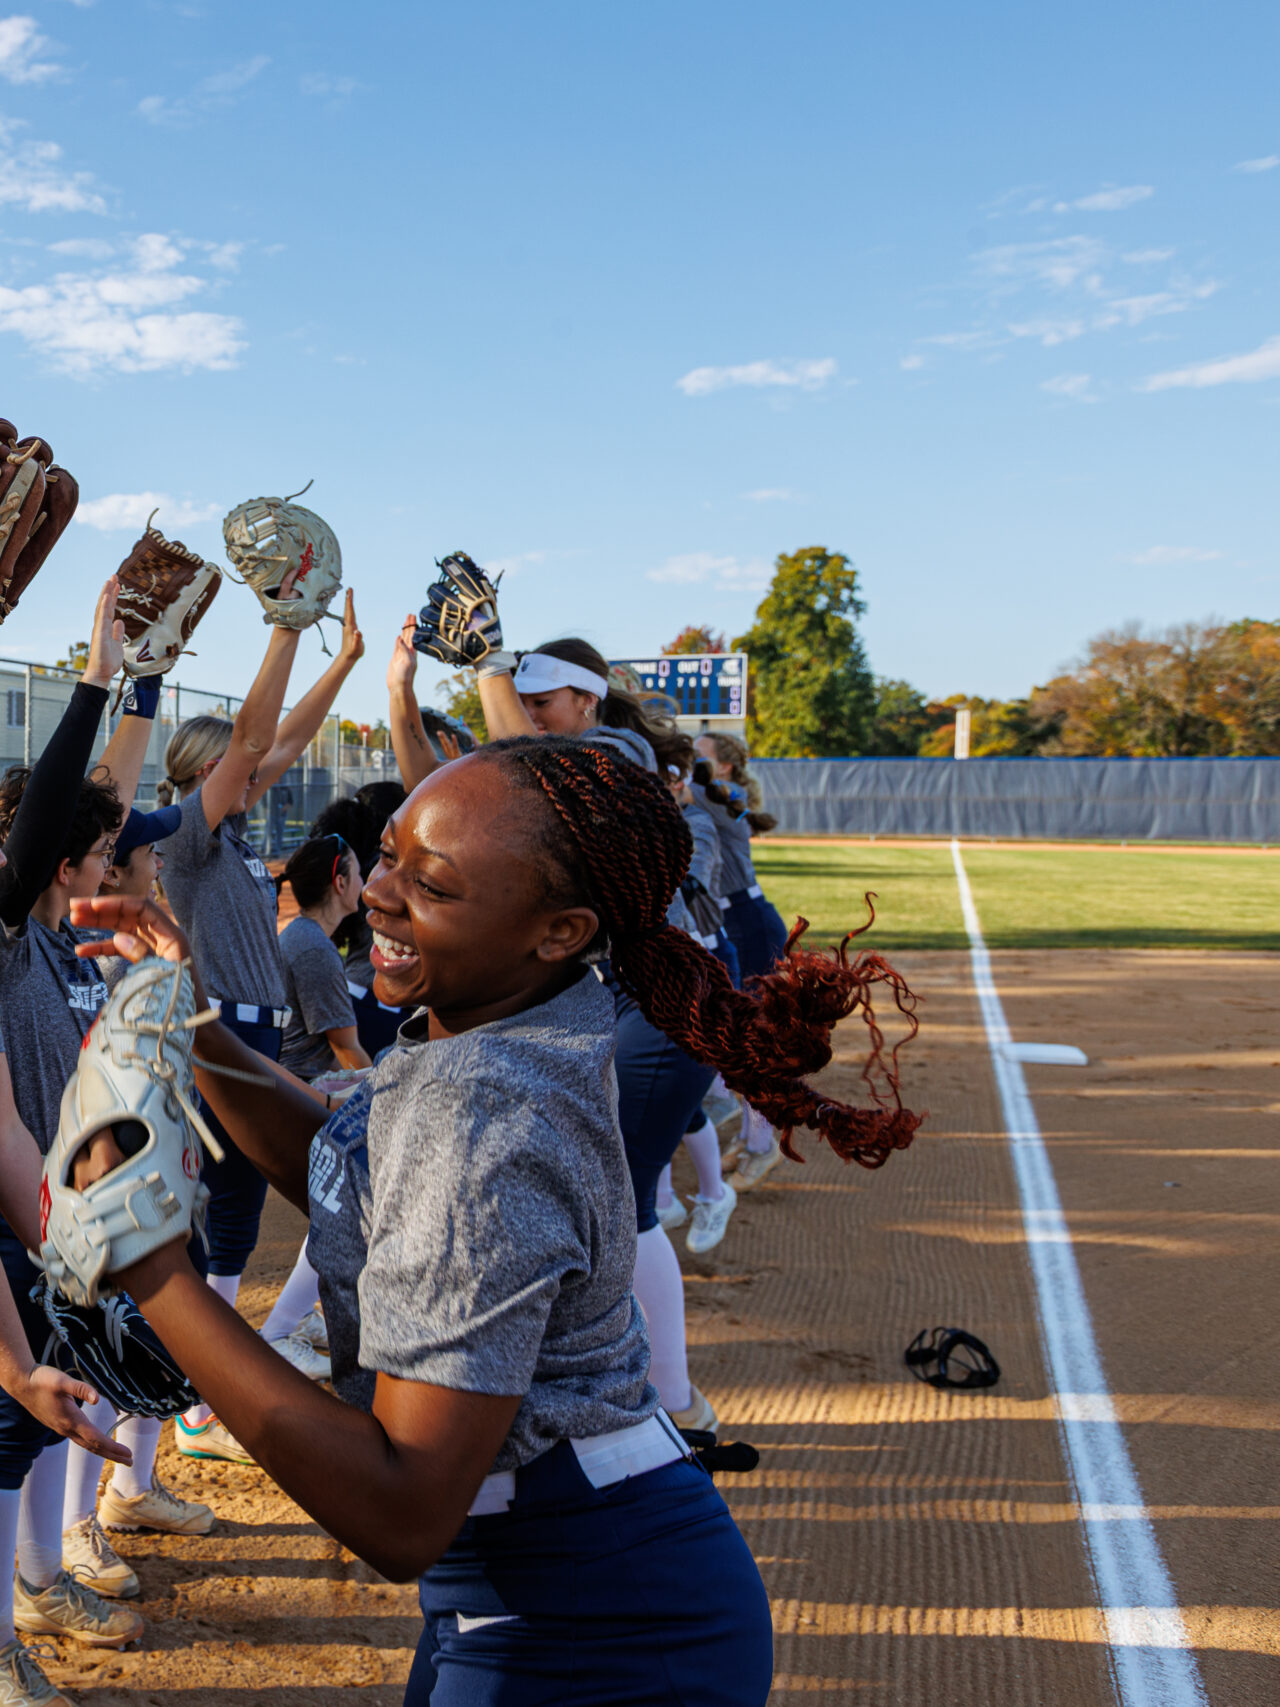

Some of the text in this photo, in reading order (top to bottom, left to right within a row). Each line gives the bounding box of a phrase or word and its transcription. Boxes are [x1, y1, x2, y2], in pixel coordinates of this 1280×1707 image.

[658, 660, 670, 677] 0
[678, 661, 699, 673] OUT
[700, 658, 712, 676] 0
[677, 677, 684, 688] 7
[730, 687, 740, 699] 0
[729, 701, 740, 713] 0
